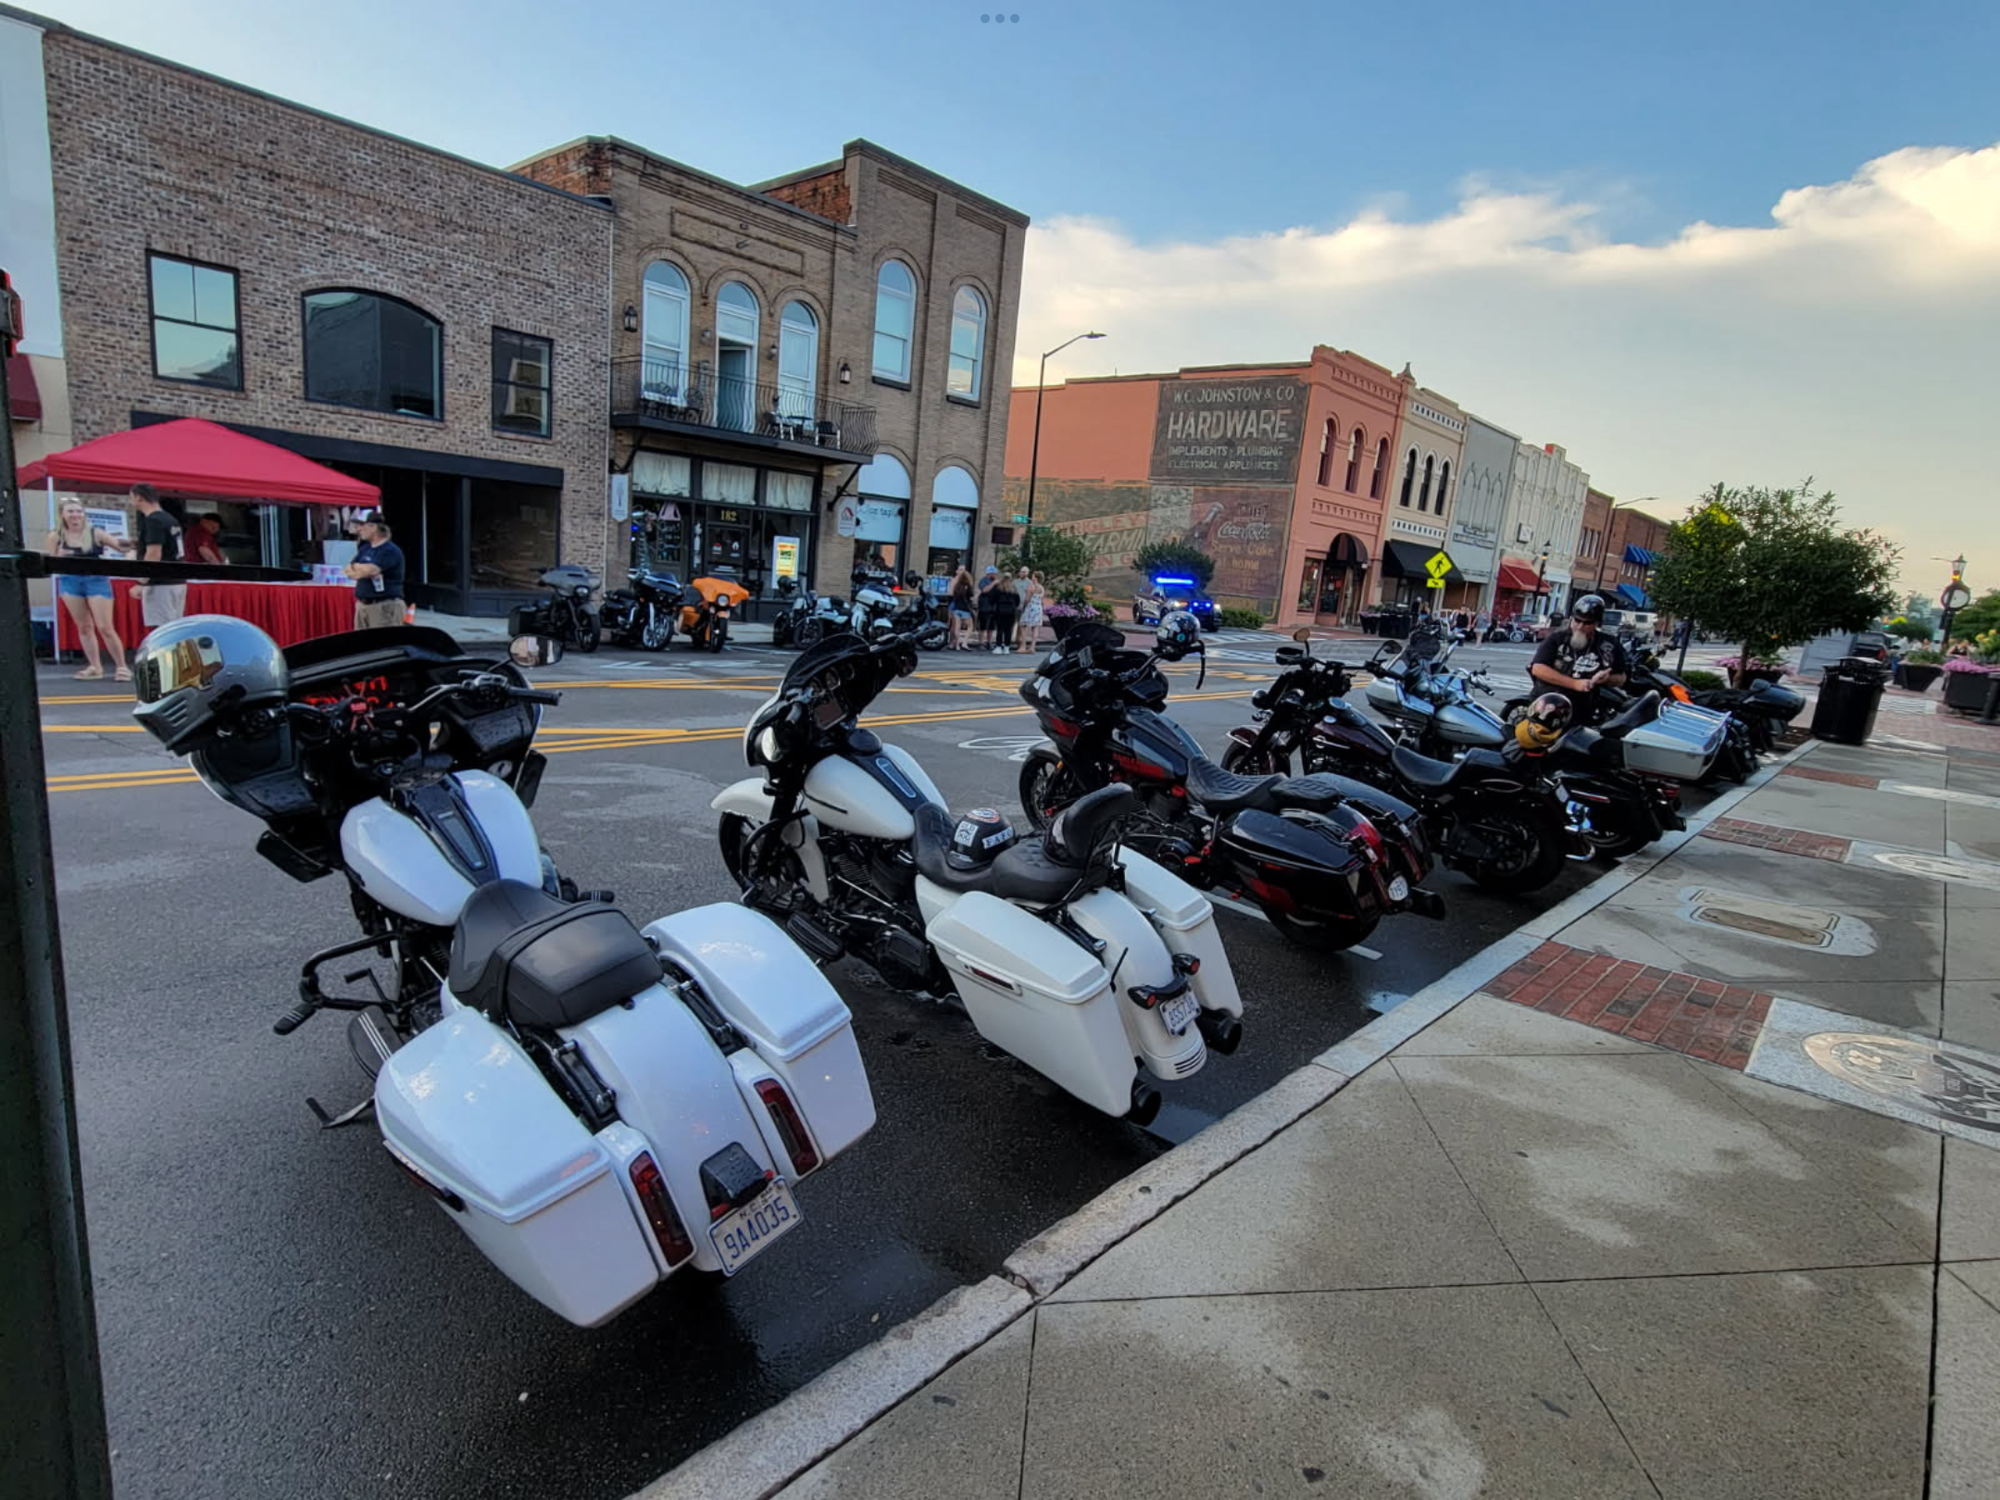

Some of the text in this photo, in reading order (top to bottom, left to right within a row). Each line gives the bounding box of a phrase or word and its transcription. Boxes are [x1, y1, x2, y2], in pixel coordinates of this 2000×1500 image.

[1196, 387, 1261, 403] JOHNSTON
[1264, 388, 1272, 399] &
[1167, 408, 1292, 440] HARDWARE
[1169, 445, 1284, 457] IMPLEMENTS PLUMBING
[1168, 460, 1219, 470] ELECTRICAL
[721, 509, 737, 521] 182
[723, 1195, 790, 1260] 9A4035
